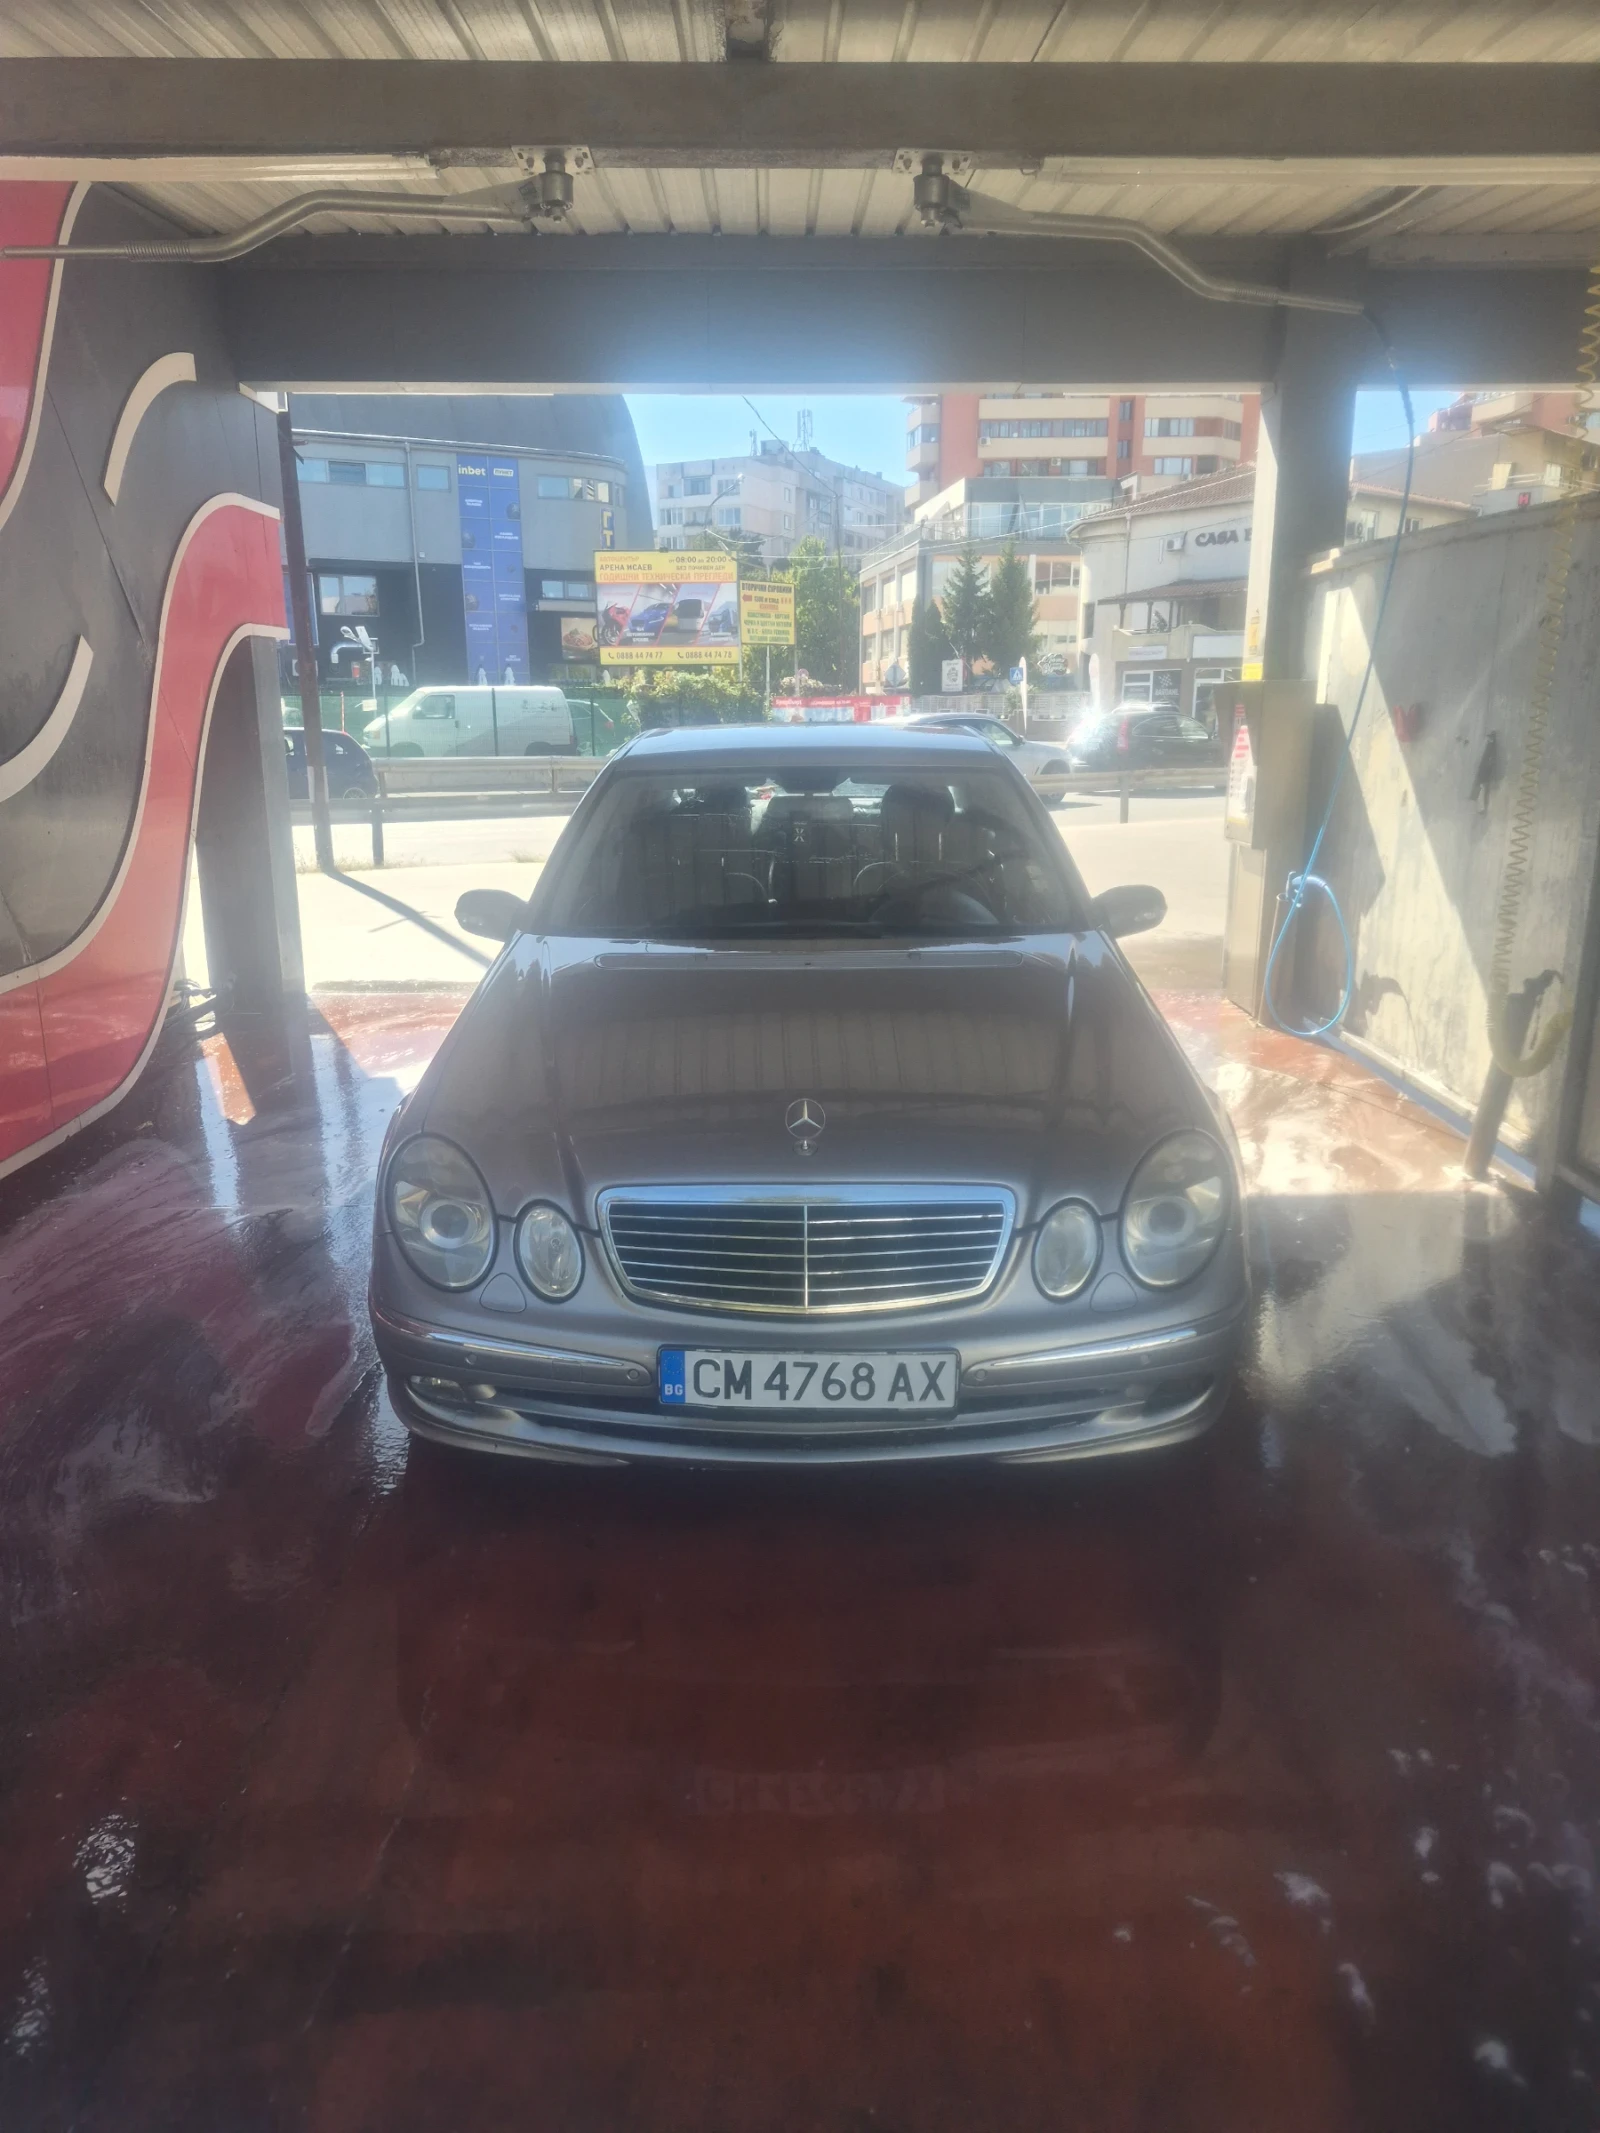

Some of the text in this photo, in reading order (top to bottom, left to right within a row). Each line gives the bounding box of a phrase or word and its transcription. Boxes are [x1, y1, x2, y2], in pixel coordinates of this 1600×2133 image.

[458, 464, 486, 477] inbet
[1195, 530, 1239, 547] CASA
[600, 572, 734, 582] ГОДИШНИ ТЕХНИЧЕСКИ ПРЕГЛЕДИ
[616, 652, 634, 660] 0888
[685, 651, 703, 659] 0888
[714, 651, 722, 659] 74
[724, 651, 732, 659] 78
[693, 1358, 948, 1403] CM 4768 AX
[664, 1383, 684, 1396] BG
